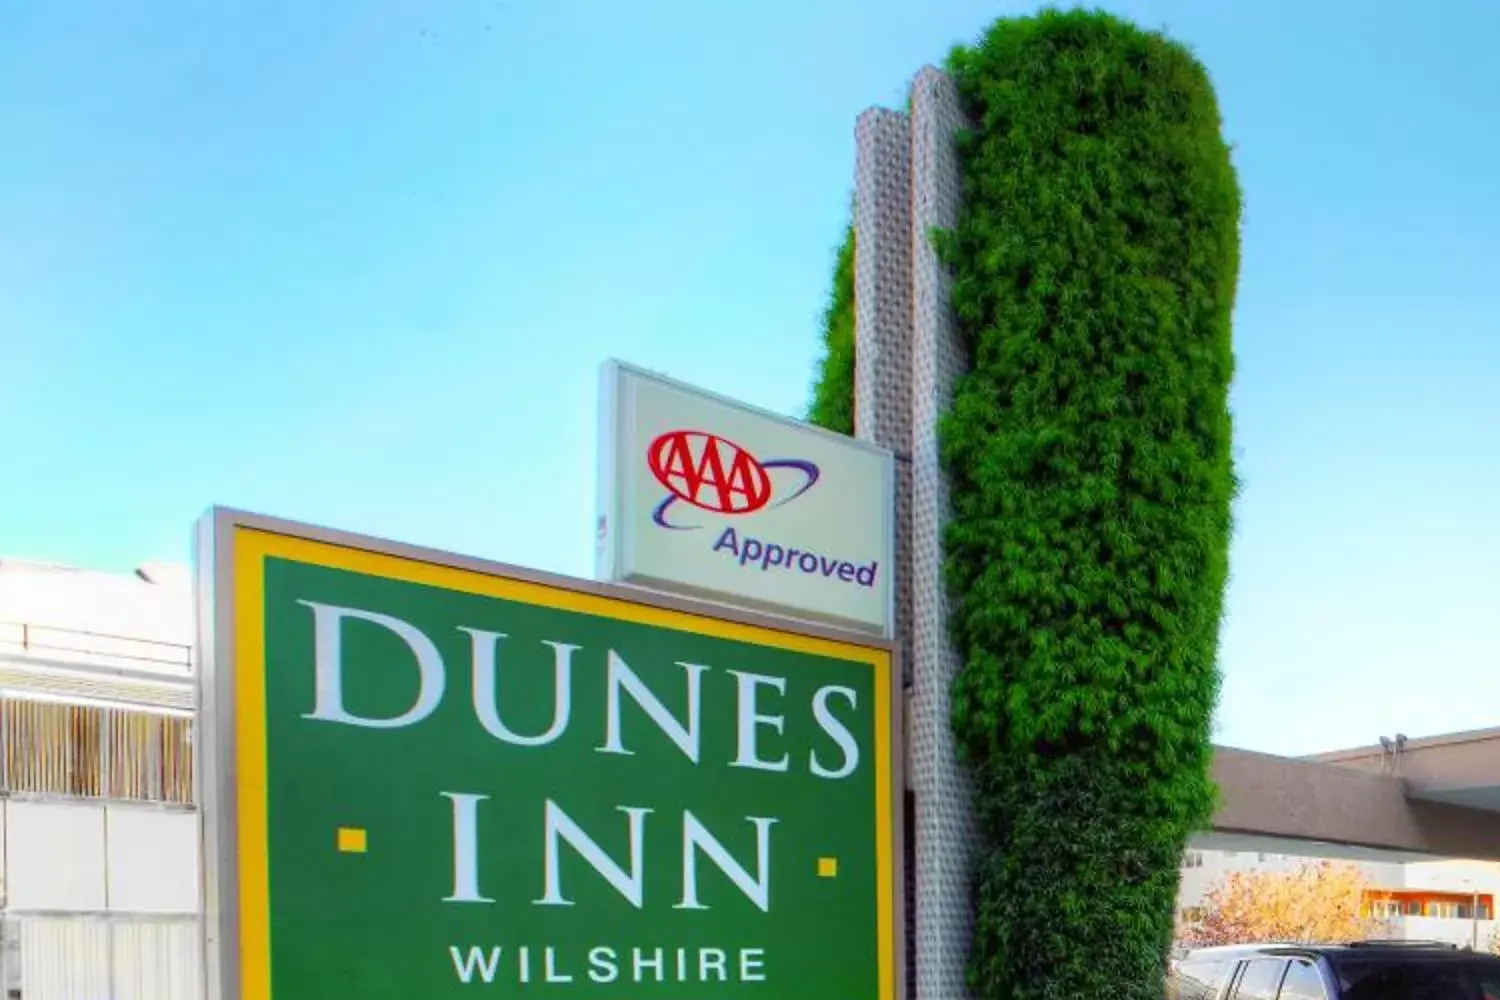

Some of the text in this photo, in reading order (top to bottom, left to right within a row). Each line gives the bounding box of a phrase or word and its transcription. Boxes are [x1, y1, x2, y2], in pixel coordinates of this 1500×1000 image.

[657, 430, 761, 513] AAA
[712, 526, 878, 588] Approved
[295, 598, 861, 780] DUNES
[440, 791, 779, 914] INN
[449, 945, 768, 985] WILSHIRE
